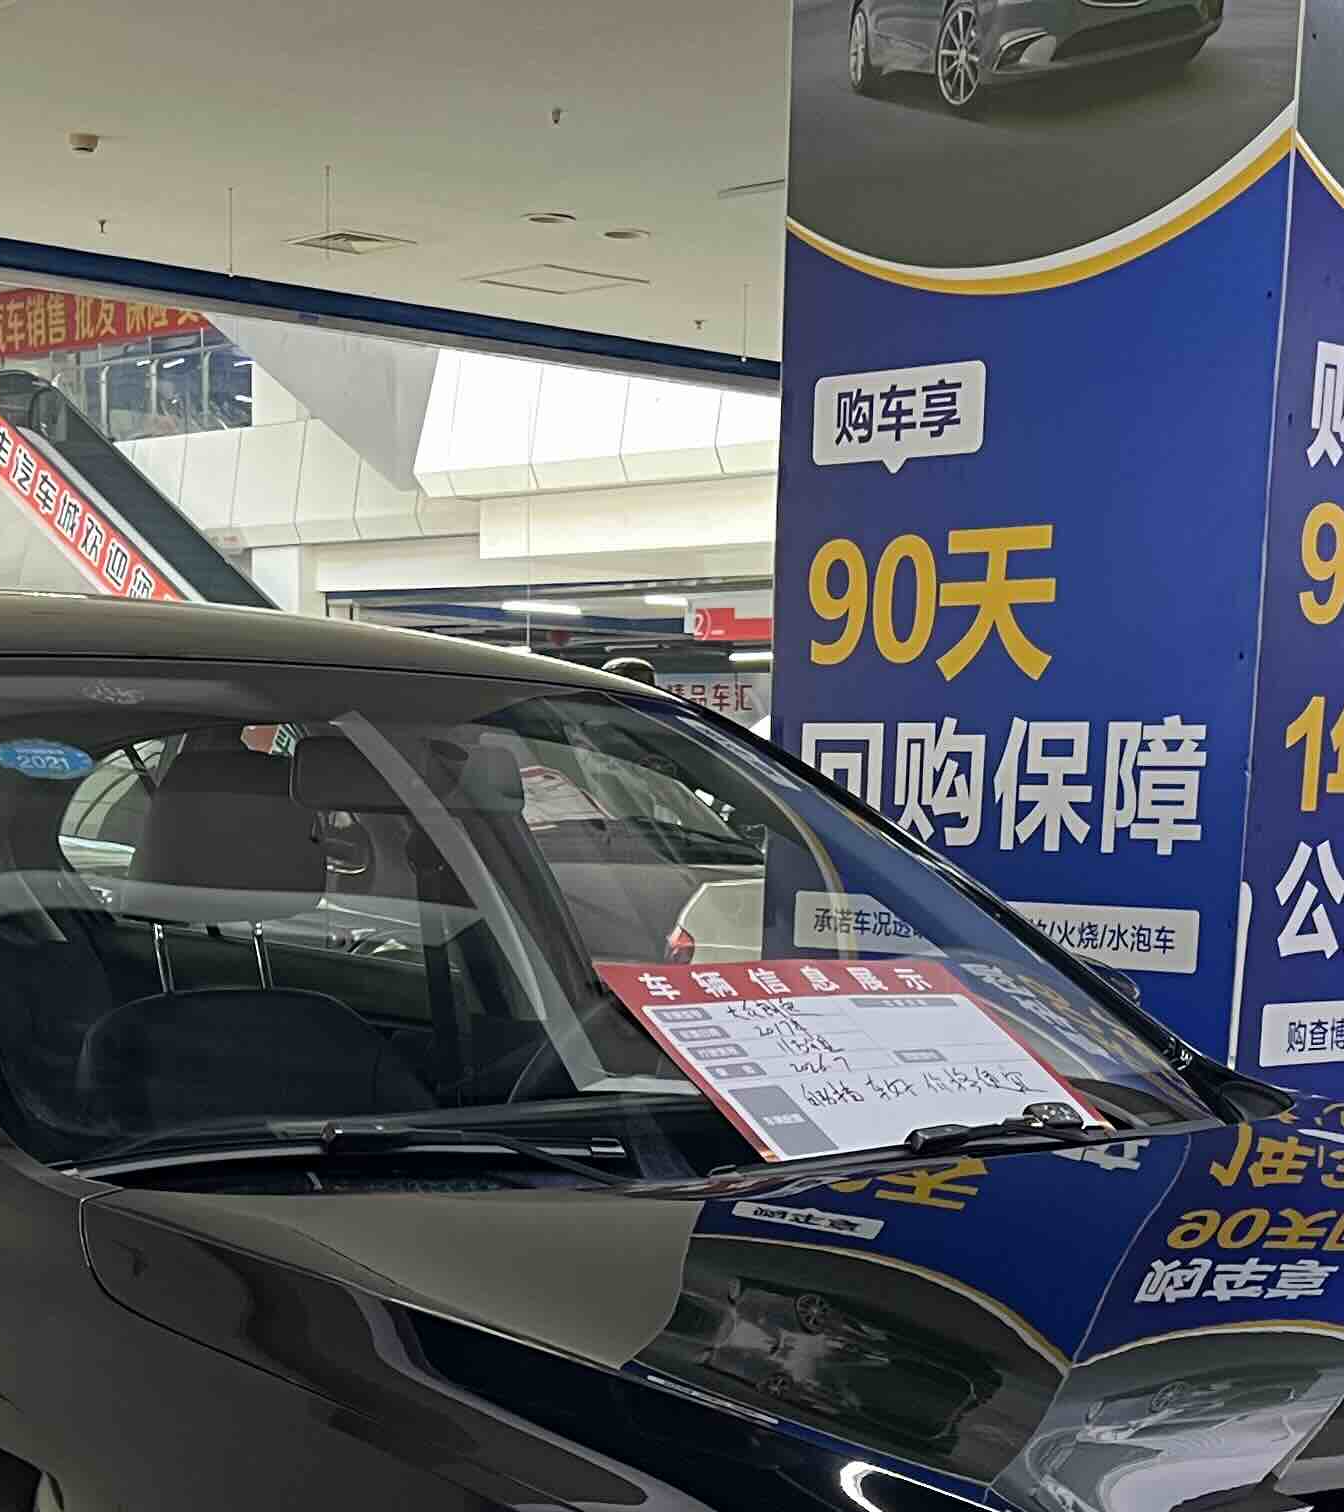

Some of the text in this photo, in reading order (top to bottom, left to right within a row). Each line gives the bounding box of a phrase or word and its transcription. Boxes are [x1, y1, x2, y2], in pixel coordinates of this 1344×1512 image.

[834, 378, 963, 448] 购车享
[807, 523, 1057, 682] 90天
[16, 754, 72, 770] 2021
[800, 714, 1208, 856] 回购保障
[813, 907, 920, 939] 承诺车况透
[638, 966, 933, 1000] 车辆信息展示
